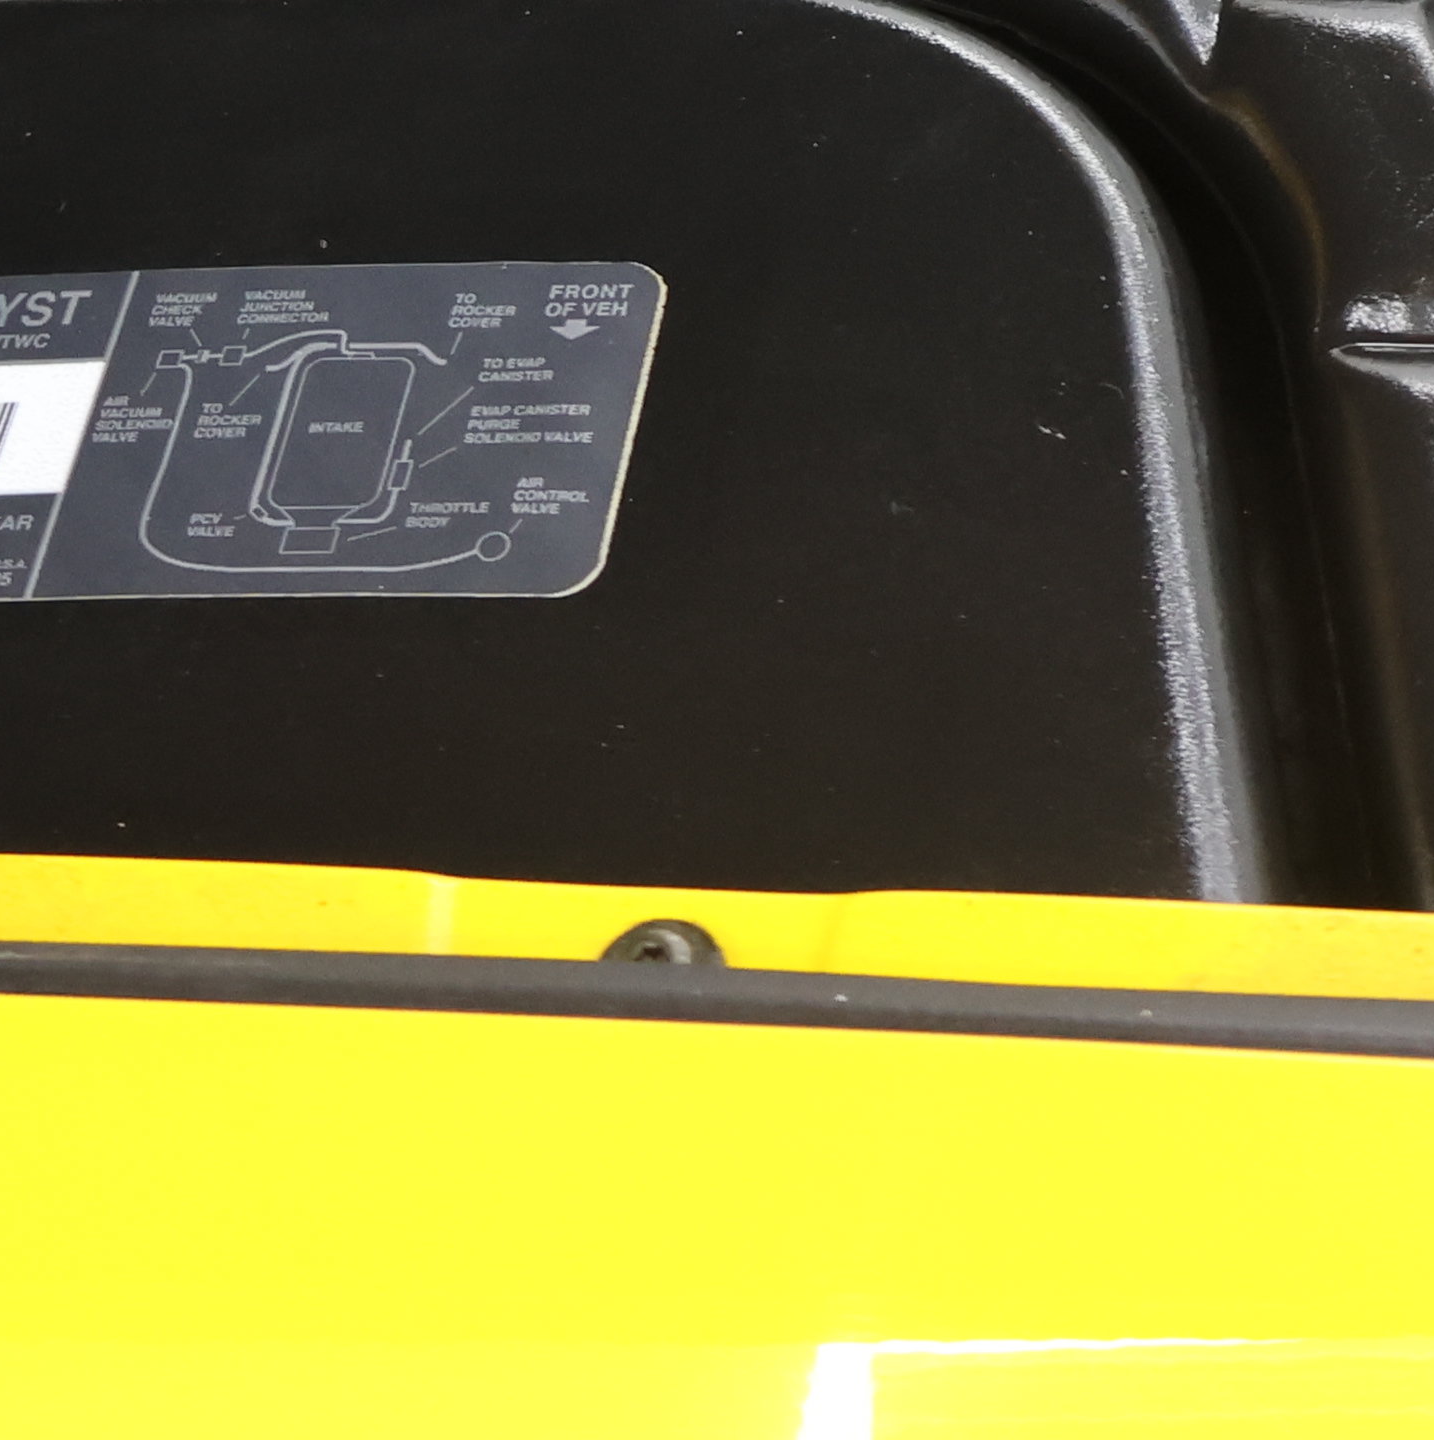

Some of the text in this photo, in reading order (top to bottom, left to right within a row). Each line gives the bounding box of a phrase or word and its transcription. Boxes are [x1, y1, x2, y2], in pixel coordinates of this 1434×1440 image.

[244, 289, 306, 301] VACUUM
[549, 283, 635, 300] FRONT
[156, 292, 218, 304] VACUUM
[456, 293, 477, 304] TO
[151, 304, 204, 316] CHECK
[239, 301, 315, 313] JUNCTION
[451, 305, 517, 316] ROCKER
[544, 301, 629, 317] OF VEH
[149, 316, 196, 327] VALVE
[236, 312, 329, 325] CONNECTOR
[448, 317, 503, 329] COVER
[483, 357, 546, 369] TO EVAP
[478, 370, 555, 382] CANISTER
[103, 396, 129, 407] AIR
[100, 407, 163, 418] VACUUM
[202, 403, 224, 414] TO
[470, 403, 592, 417] EVAP CANISTER
[95, 419, 173, 431] SOLENOID
[198, 414, 262, 426] ROCKER
[467, 418, 521, 430] PURGE
[193, 427, 247, 439] COVER
[308, 422, 365, 434] INTAKE
[92, 431, 139, 442] VALVE
[464, 431, 594, 444] SOLENOID VALVE
[515, 477, 544, 488] AIR
[514, 489, 590, 503] CONTROL
[409, 501, 491, 515] THROTTLE
[510, 502, 561, 515] VALVE
[405, 516, 452, 529] BODY
[187, 525, 235, 538] VALVE
